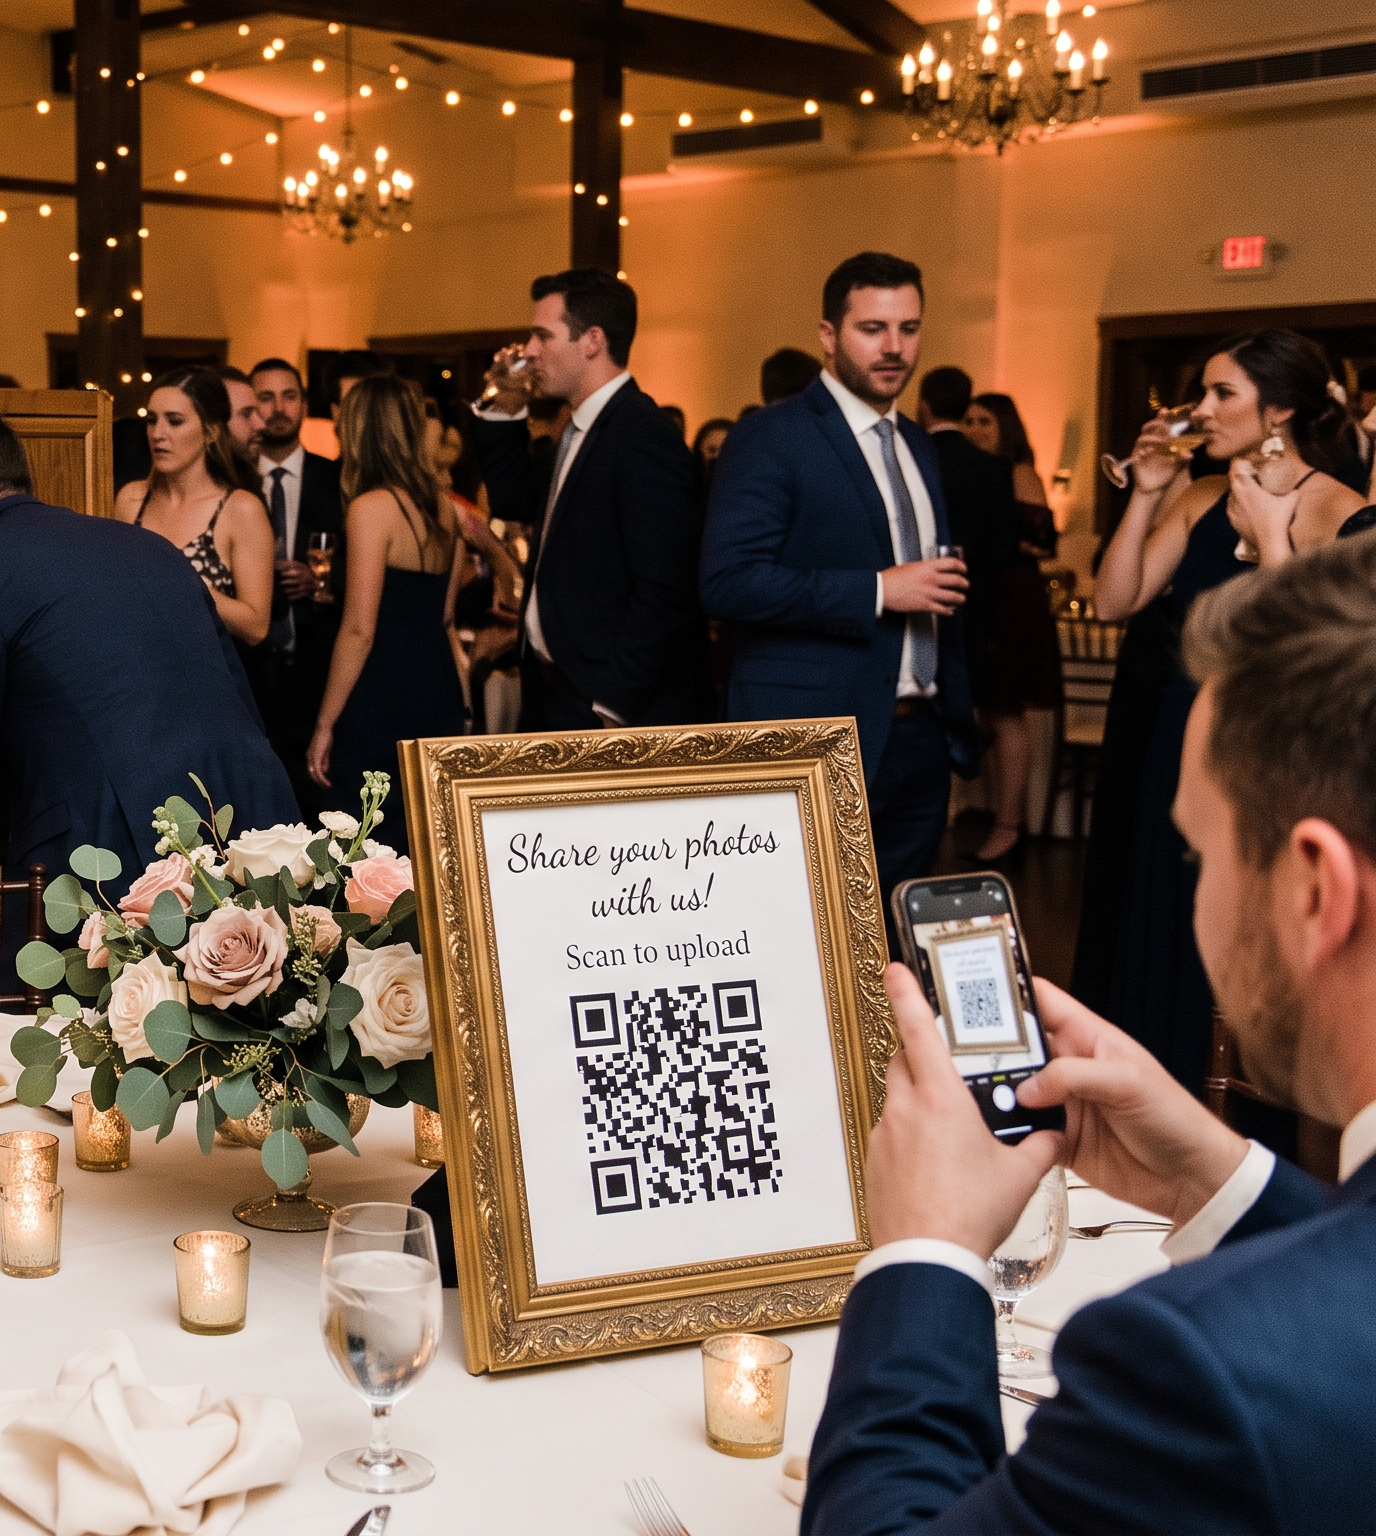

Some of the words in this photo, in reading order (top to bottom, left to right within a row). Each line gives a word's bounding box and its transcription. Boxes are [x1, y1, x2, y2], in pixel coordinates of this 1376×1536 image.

[508, 833, 600, 873] Share
[610, 838, 676, 875] your
[685, 820, 780, 869] photos
[592, 877, 660, 918] with
[671, 872, 715, 911] us!
[566, 944, 627, 970] Scan
[634, 943, 658, 964] to
[666, 930, 751, 967] upload
